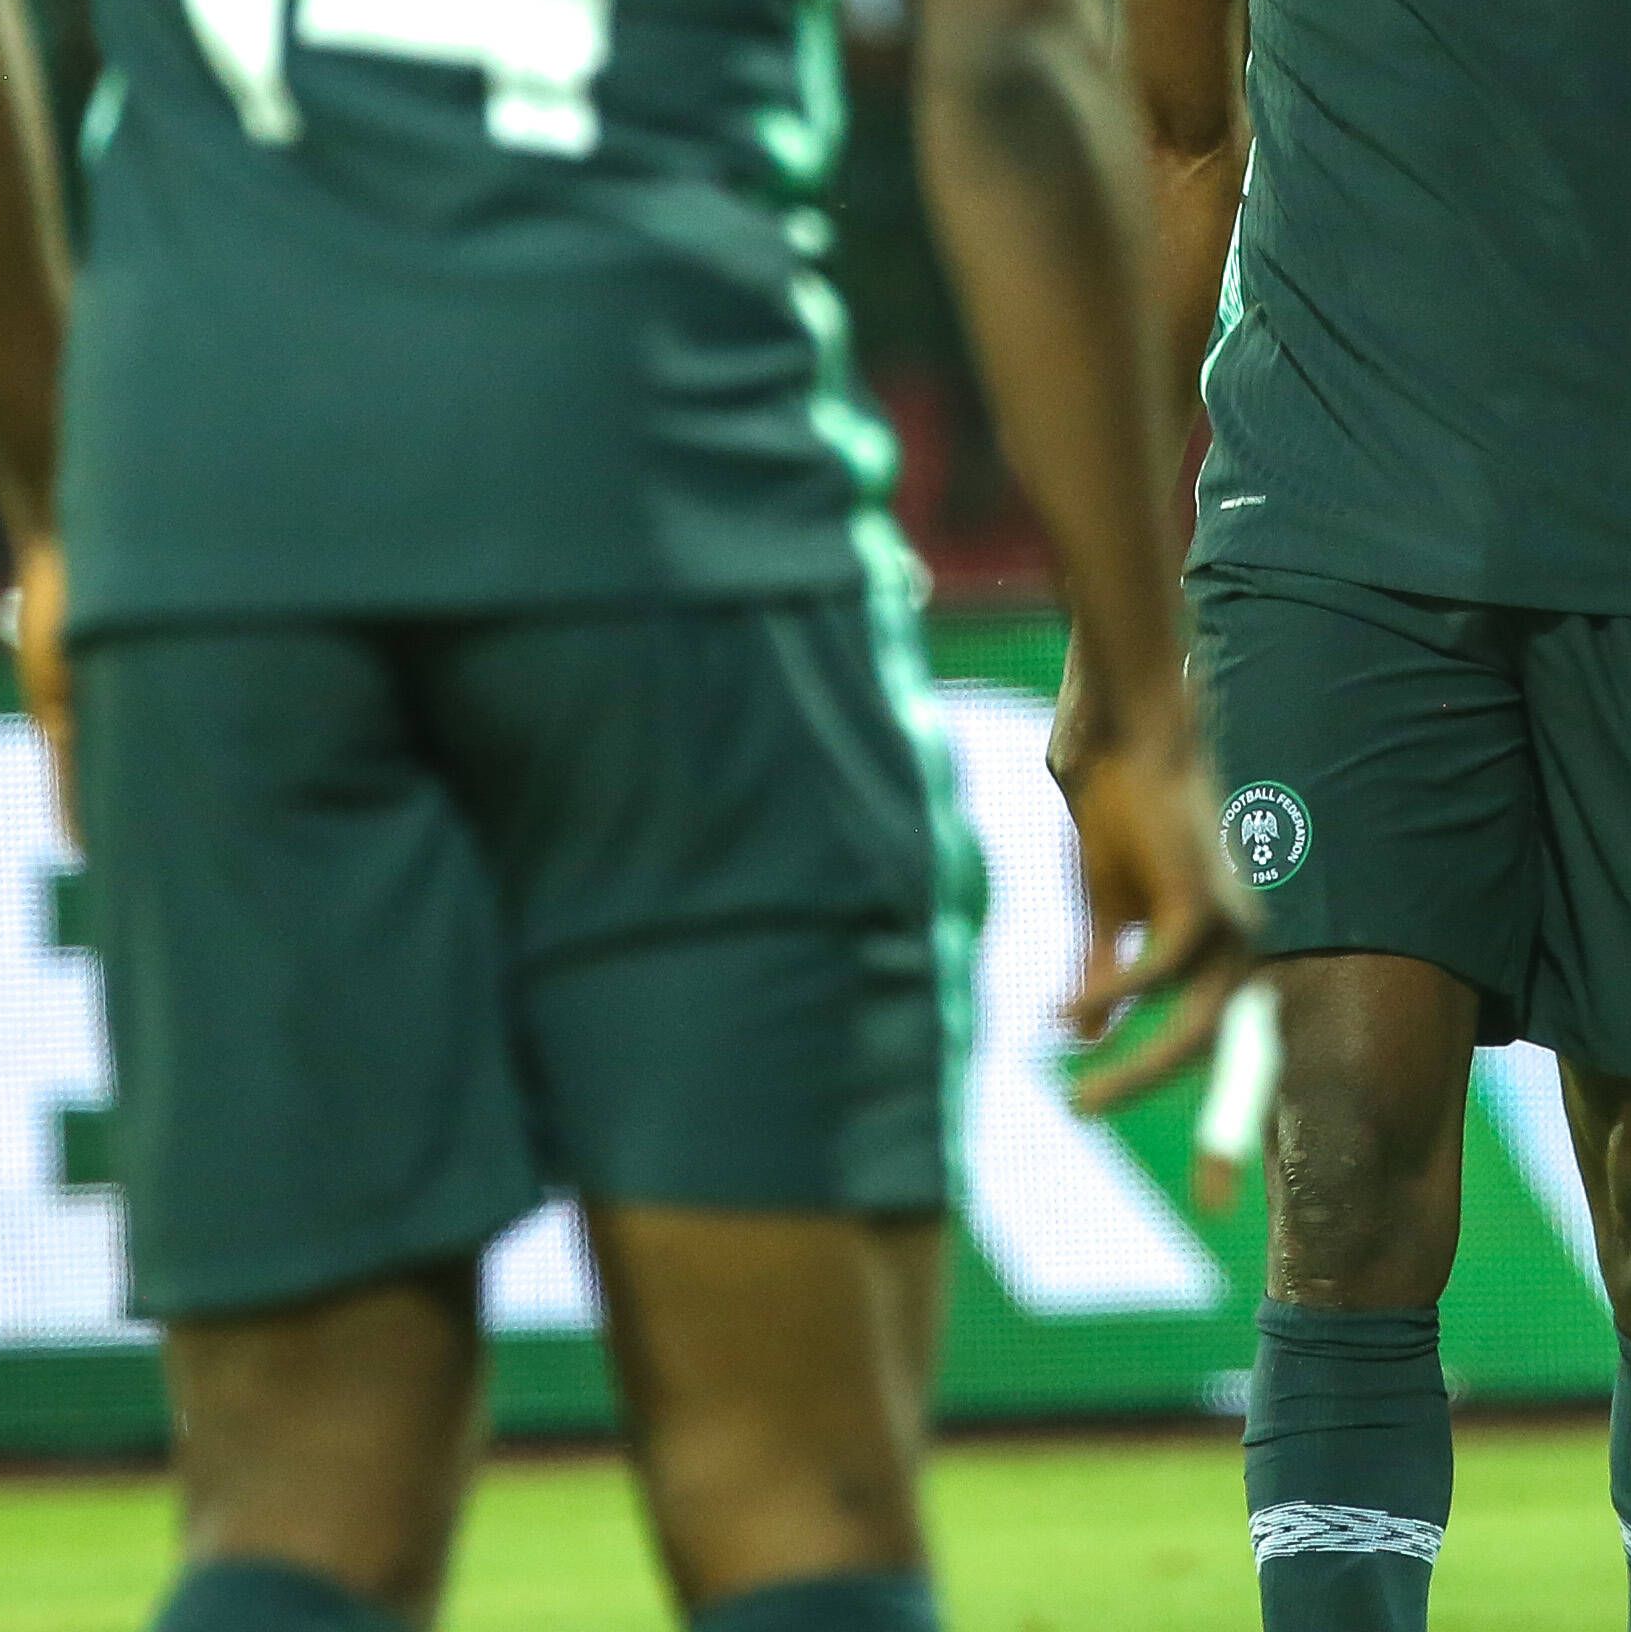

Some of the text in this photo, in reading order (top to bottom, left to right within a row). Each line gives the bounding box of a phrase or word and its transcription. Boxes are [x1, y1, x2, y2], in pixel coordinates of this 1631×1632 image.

[1222, 788, 1276, 828] FOOTBALL
[1276, 793, 1306, 864] FEDERATION
[1253, 867, 1279, 884] 1945
